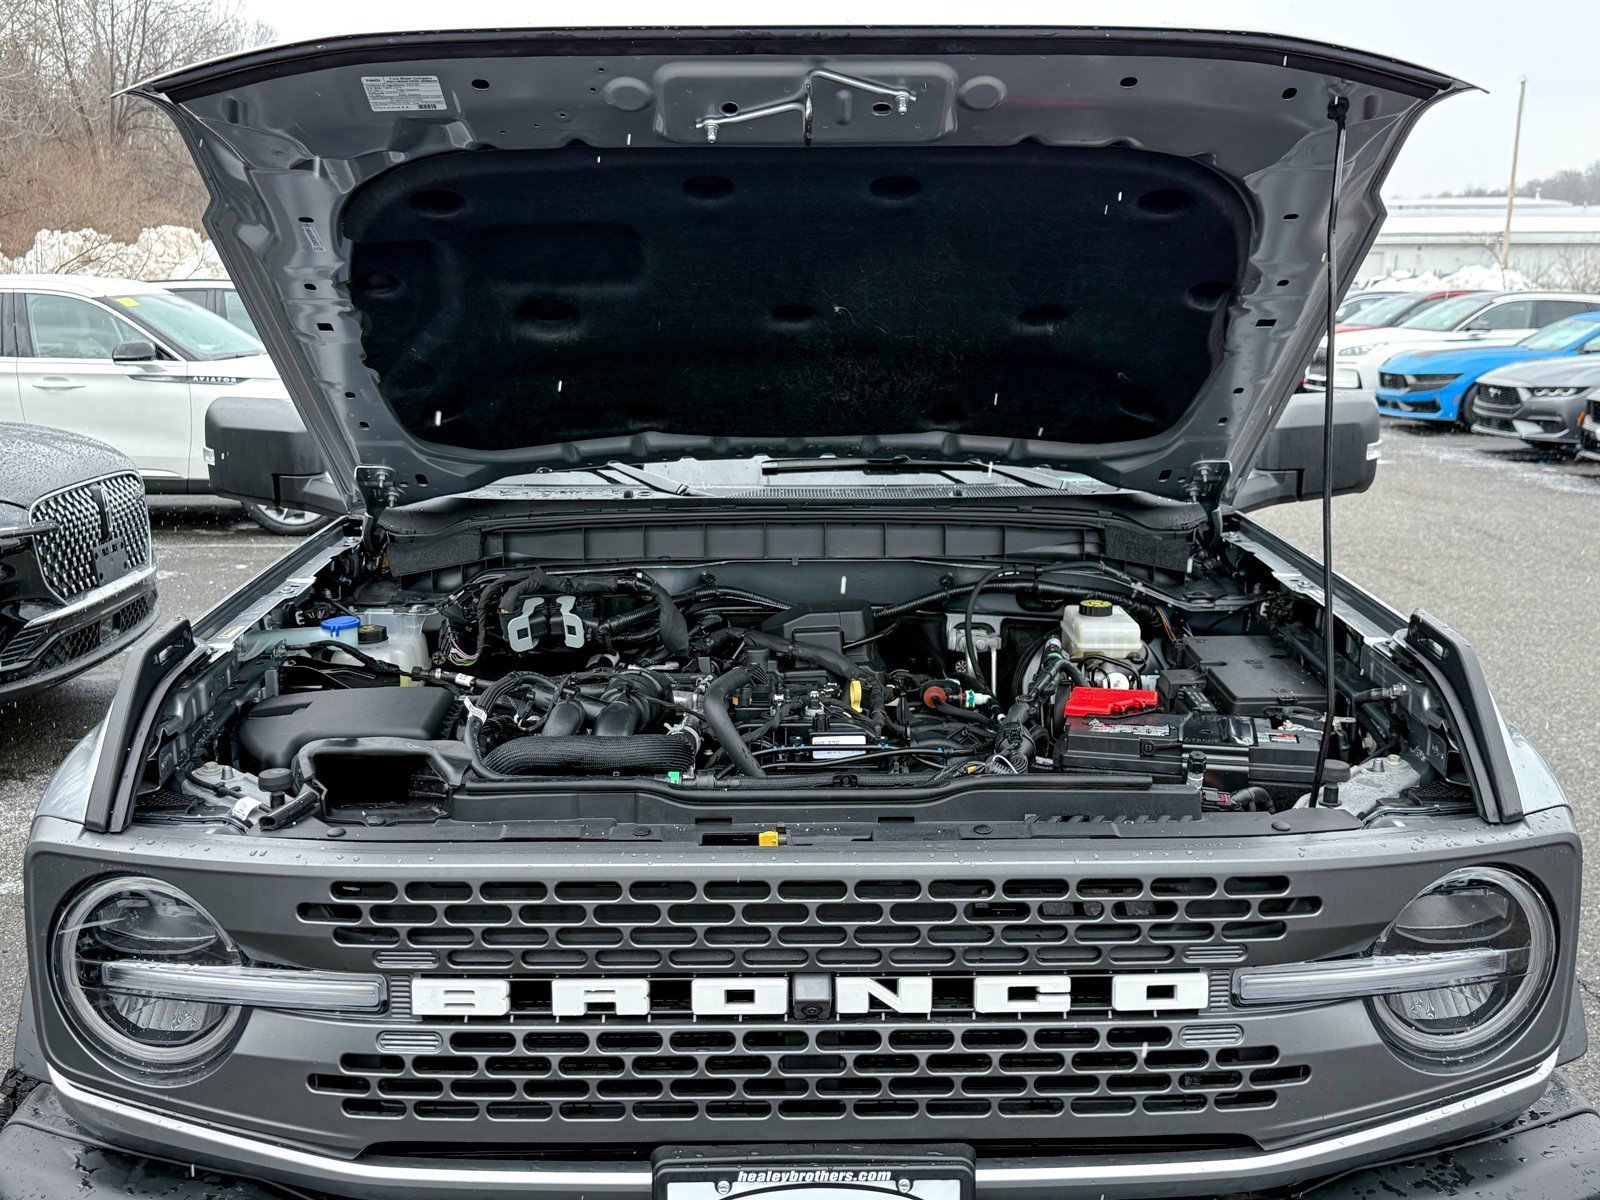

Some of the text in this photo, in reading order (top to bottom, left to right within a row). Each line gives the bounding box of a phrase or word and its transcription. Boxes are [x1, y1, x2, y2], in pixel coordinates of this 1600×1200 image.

[193, 376, 237, 384] AVIATOR
[412, 973, 1209, 1015] BRONCO
[737, 1170, 892, 1184] healeybrothers.com
